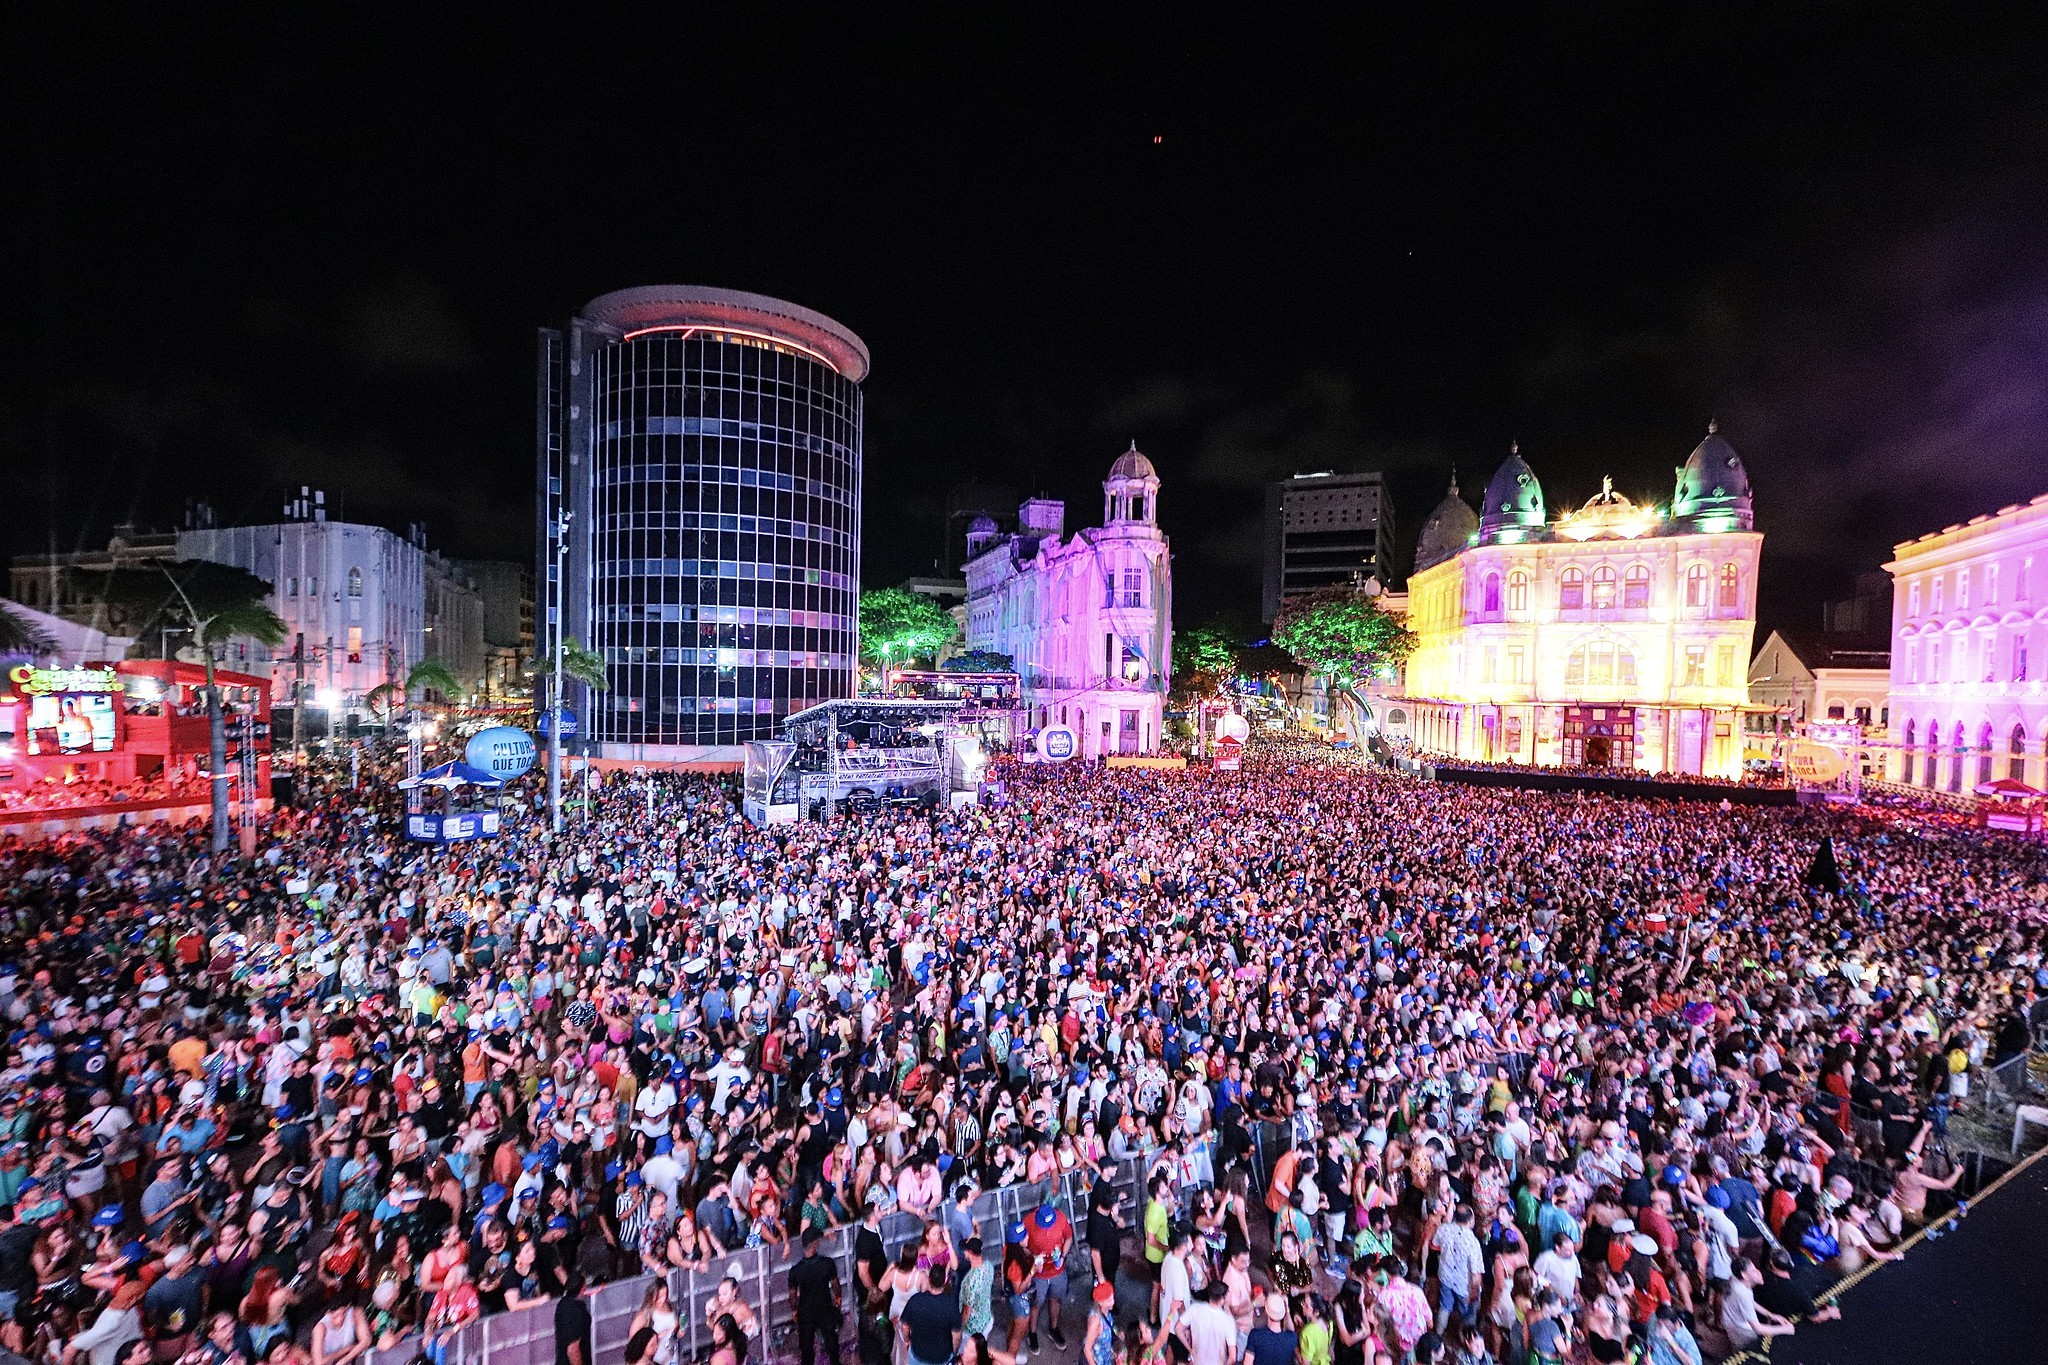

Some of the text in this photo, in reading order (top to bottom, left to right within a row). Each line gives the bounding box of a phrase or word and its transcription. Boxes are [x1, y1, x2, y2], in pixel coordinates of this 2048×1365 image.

[493, 758, 513, 771] QUE
[1794, 756, 1815, 766] TURA
[1796, 767, 1818, 775] TOCA
